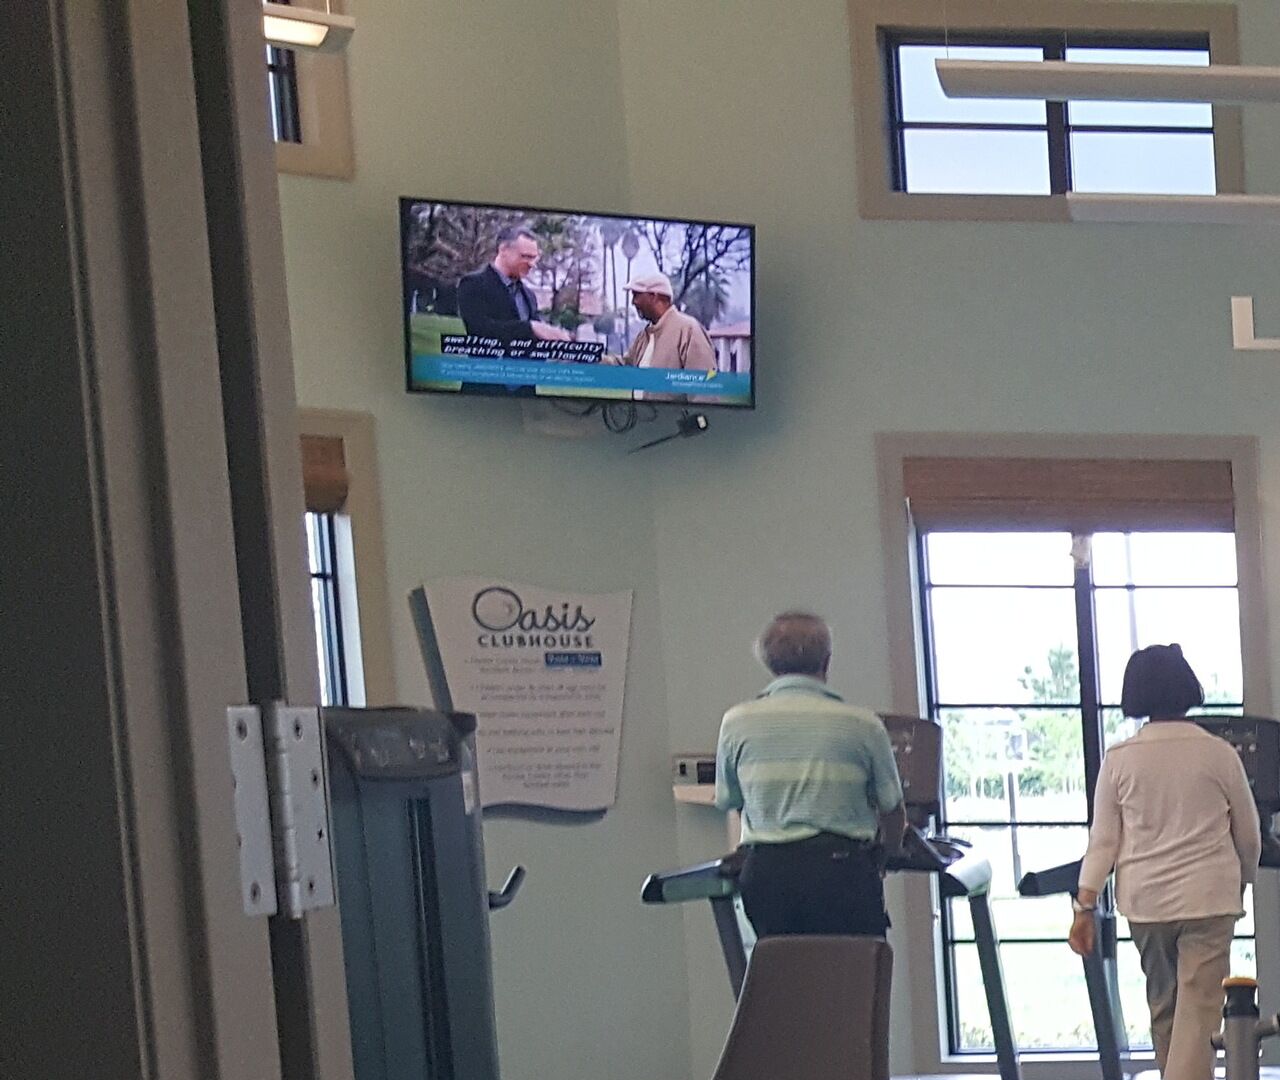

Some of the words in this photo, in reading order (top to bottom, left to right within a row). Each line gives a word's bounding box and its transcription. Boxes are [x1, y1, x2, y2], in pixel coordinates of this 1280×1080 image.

[444, 336, 503, 348] swelling,
[510, 339, 531, 349] and
[536, 340, 602, 353] difficulty
[444, 346, 505, 358] breathing
[510, 350, 525, 358] or
[530, 350, 600, 363] swallowing.
[472, 586, 596, 632] Oasis
[478, 634, 595, 649] CLUBHOUSE
